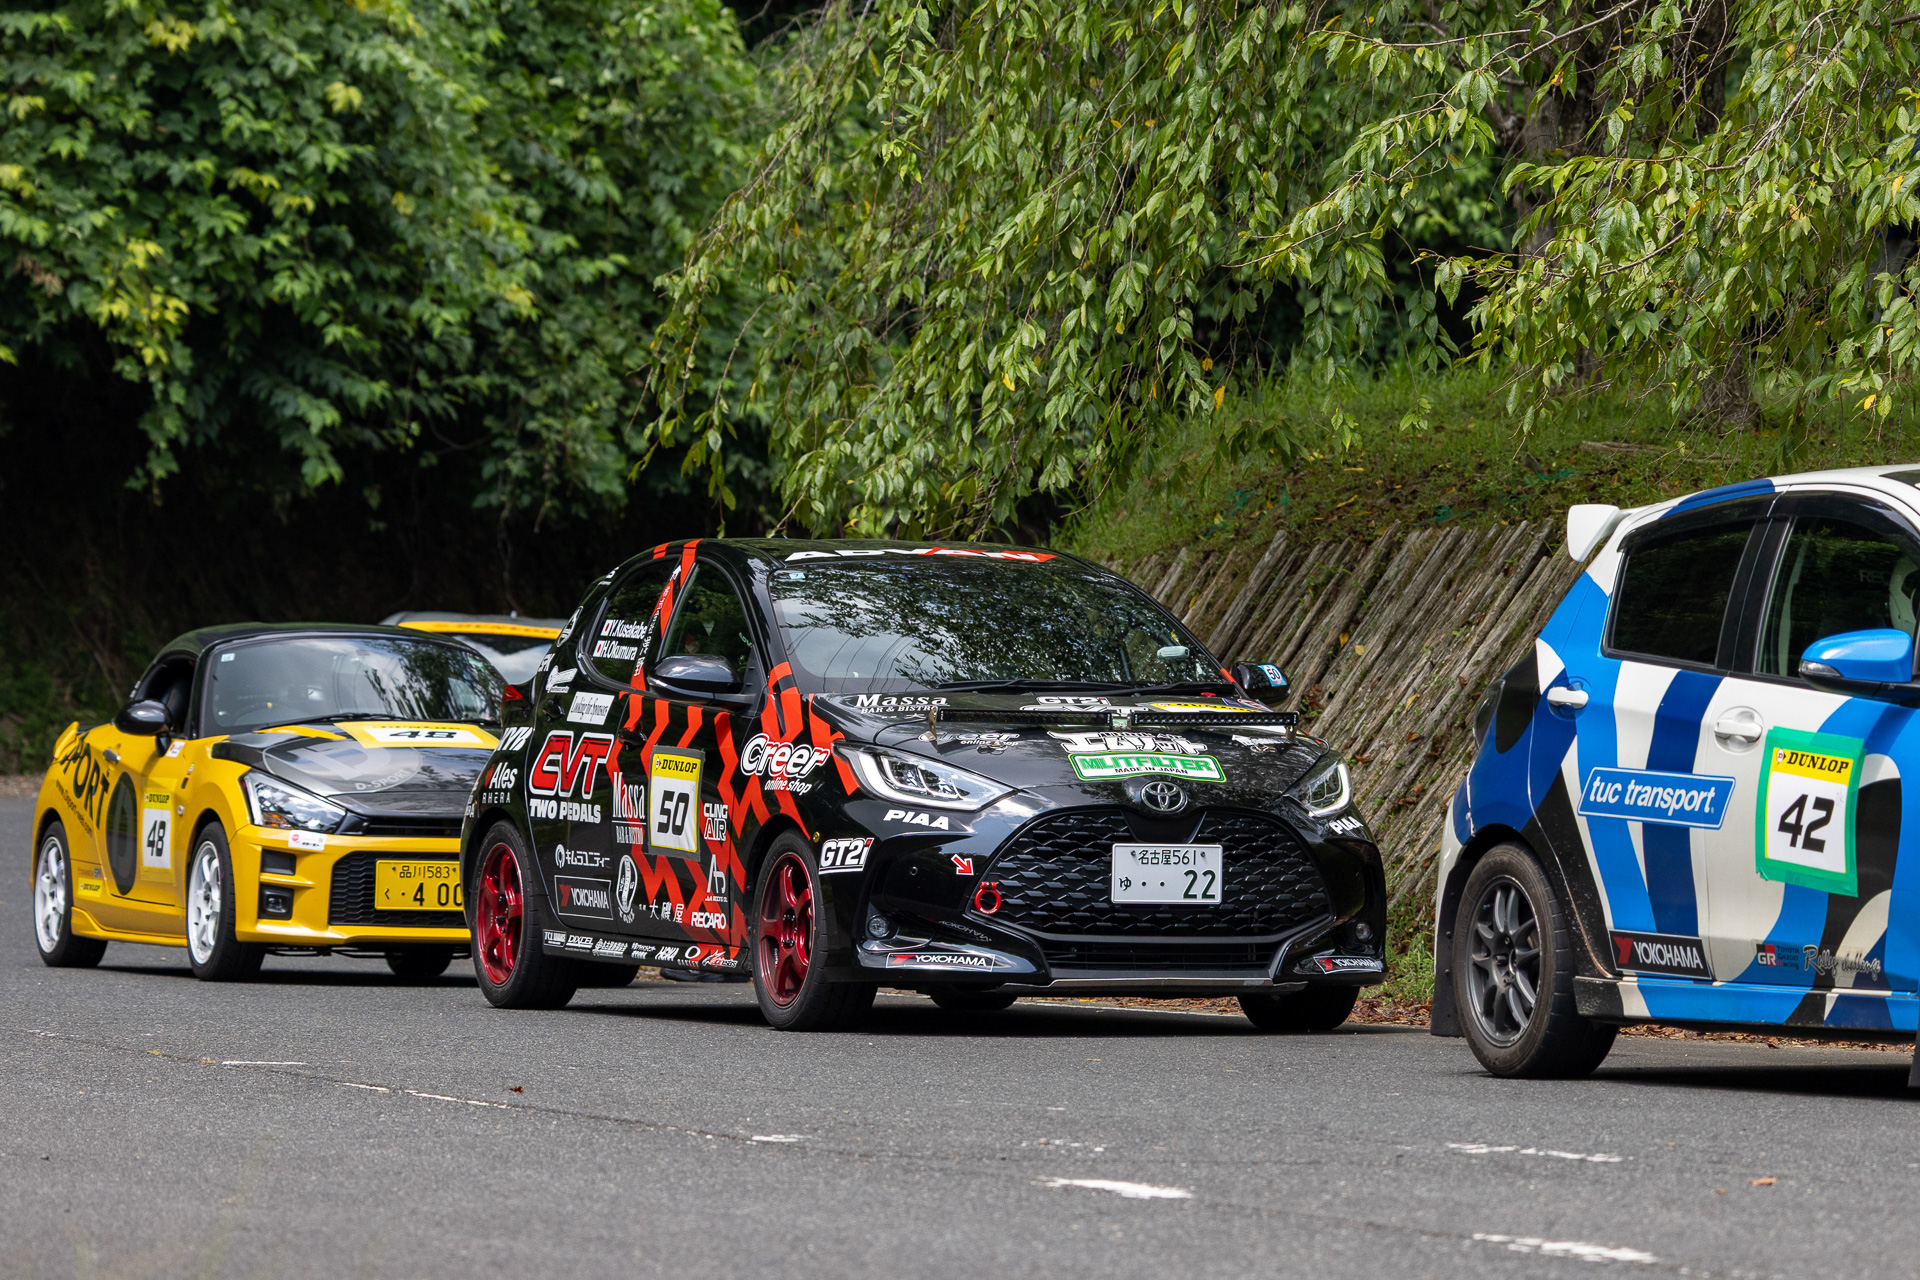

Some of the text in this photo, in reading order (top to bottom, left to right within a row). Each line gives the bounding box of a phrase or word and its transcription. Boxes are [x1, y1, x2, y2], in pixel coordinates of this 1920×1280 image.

[1267, 668, 1281, 680] 50
[854, 694, 949, 708] Massa
[861, 706, 883, 714] BAR
[389, 730, 458, 739] 48
[529, 730, 615, 799] CVT
[661, 758, 698, 774] DUNLOP
[741, 733, 831, 778] Creer
[1079, 757, 1212, 772] MLITFILTER
[1787, 752, 1849, 774] DUNLOP
[354, 769, 413, 791] D-SPORT
[489, 762, 518, 789] Ales
[1159, 766, 1189, 775] JAPAN
[613, 772, 645, 820] Massa
[765, 777, 812, 795] online shop
[1590, 776, 1716, 816] tuc transport
[530, 799, 601, 824] TWO PEDALS
[657, 790, 690, 836] 50
[704, 803, 728, 818] CLING
[883, 809, 949, 831] PIAA
[704, 818, 727, 841] AIR
[1329, 816, 1364, 835] PIAA
[1778, 794, 1835, 853] 42
[147, 820, 166, 857] 48
[819, 837, 875, 868] GT2i
[1138, 849, 1197, 865] 名古屋561
[399, 865, 450, 878] 品川583
[1119, 876, 1132, 891] ゆ
[571, 887, 609, 909] YOKOHAMA
[690, 911, 727, 930] RECARO
[915, 954, 987, 967] YOKOHAMA
[1634, 941, 1703, 969] YOKOHAMA
[1757, 952, 1777, 967] GR
[1802, 944, 1838, 978] Rally
